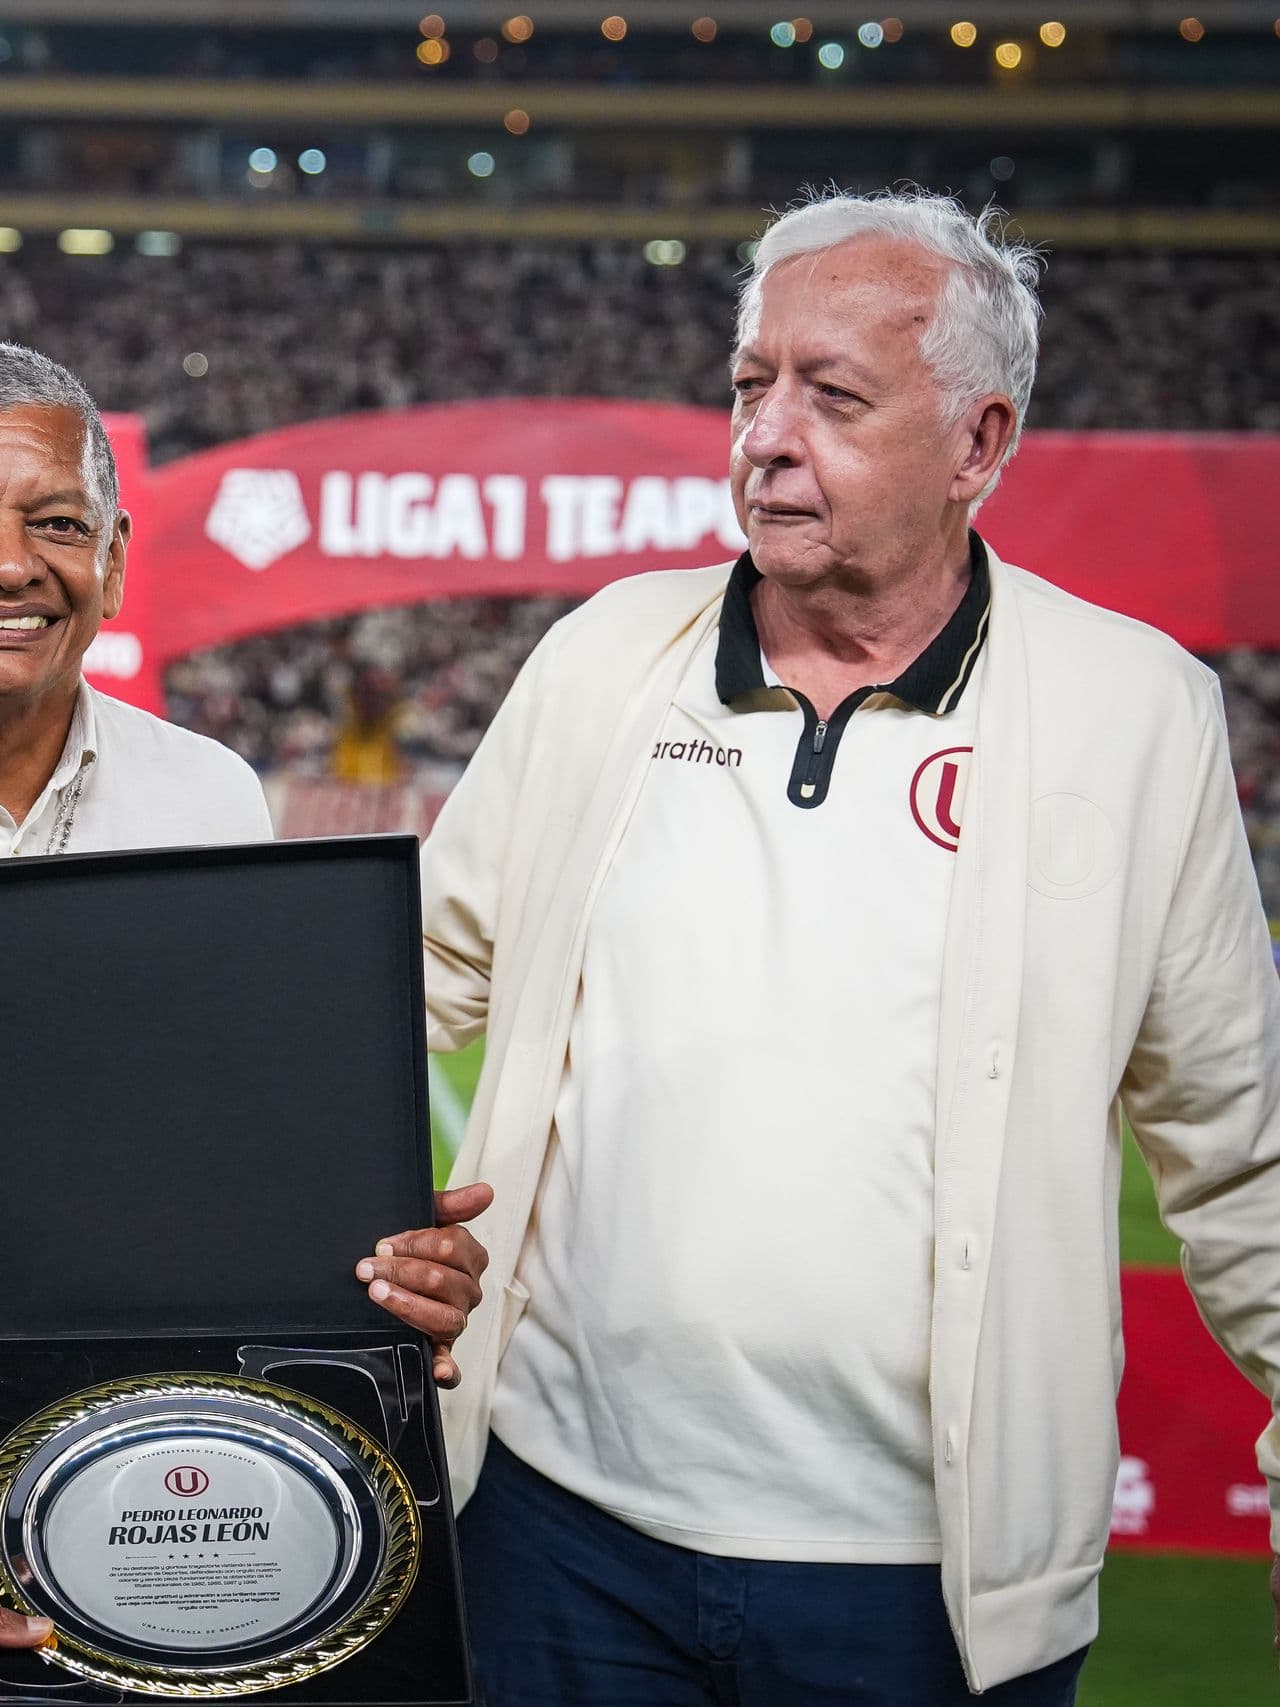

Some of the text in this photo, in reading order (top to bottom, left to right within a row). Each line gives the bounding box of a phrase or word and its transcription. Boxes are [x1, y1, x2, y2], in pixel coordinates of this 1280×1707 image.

[121, 1507, 263, 1522] PEDRO LEONARDO
[108, 1519, 270, 1545] ROJAS LEÓN
